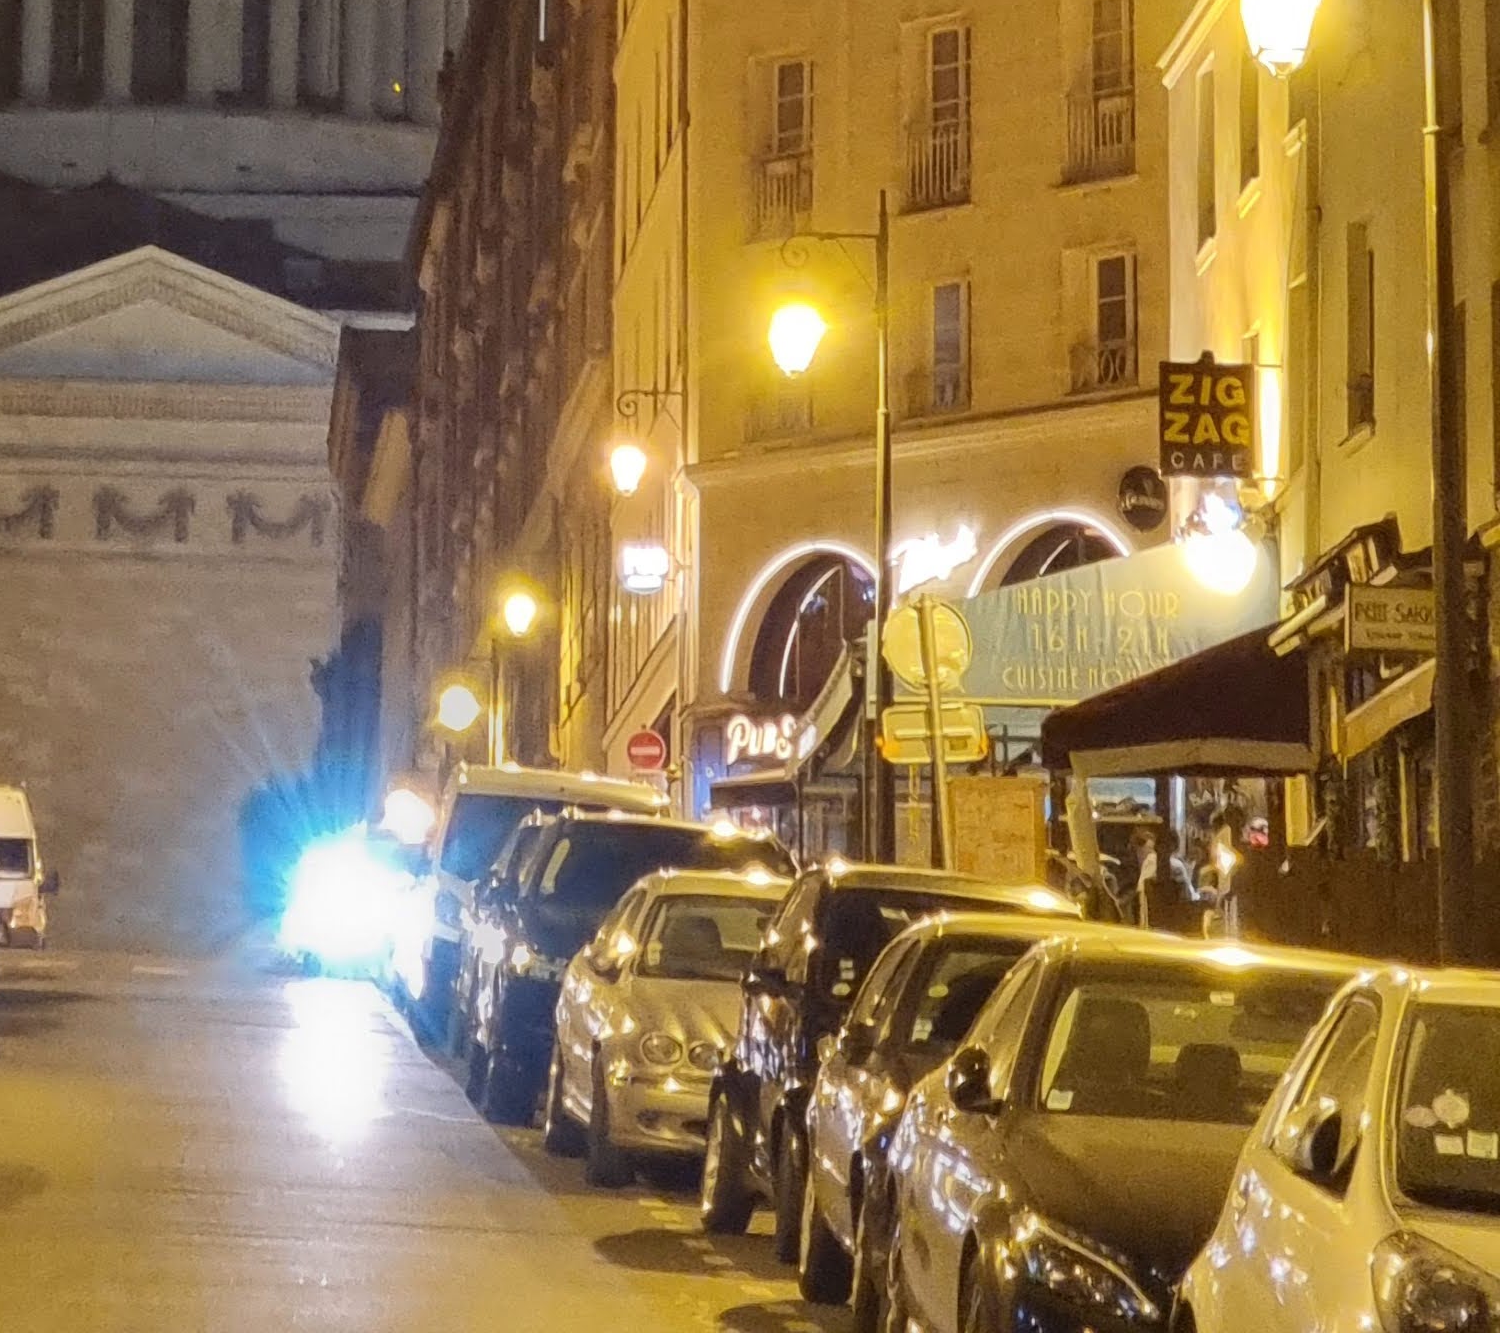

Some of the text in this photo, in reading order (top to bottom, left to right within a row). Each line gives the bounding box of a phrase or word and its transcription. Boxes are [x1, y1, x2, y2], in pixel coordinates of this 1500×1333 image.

[1168, 373, 1246, 408] ZIG
[1163, 410, 1252, 447] ZAG
[1016, 586, 1182, 619] HAPPY HOUR
[1002, 665, 1079, 692] CUISINE
